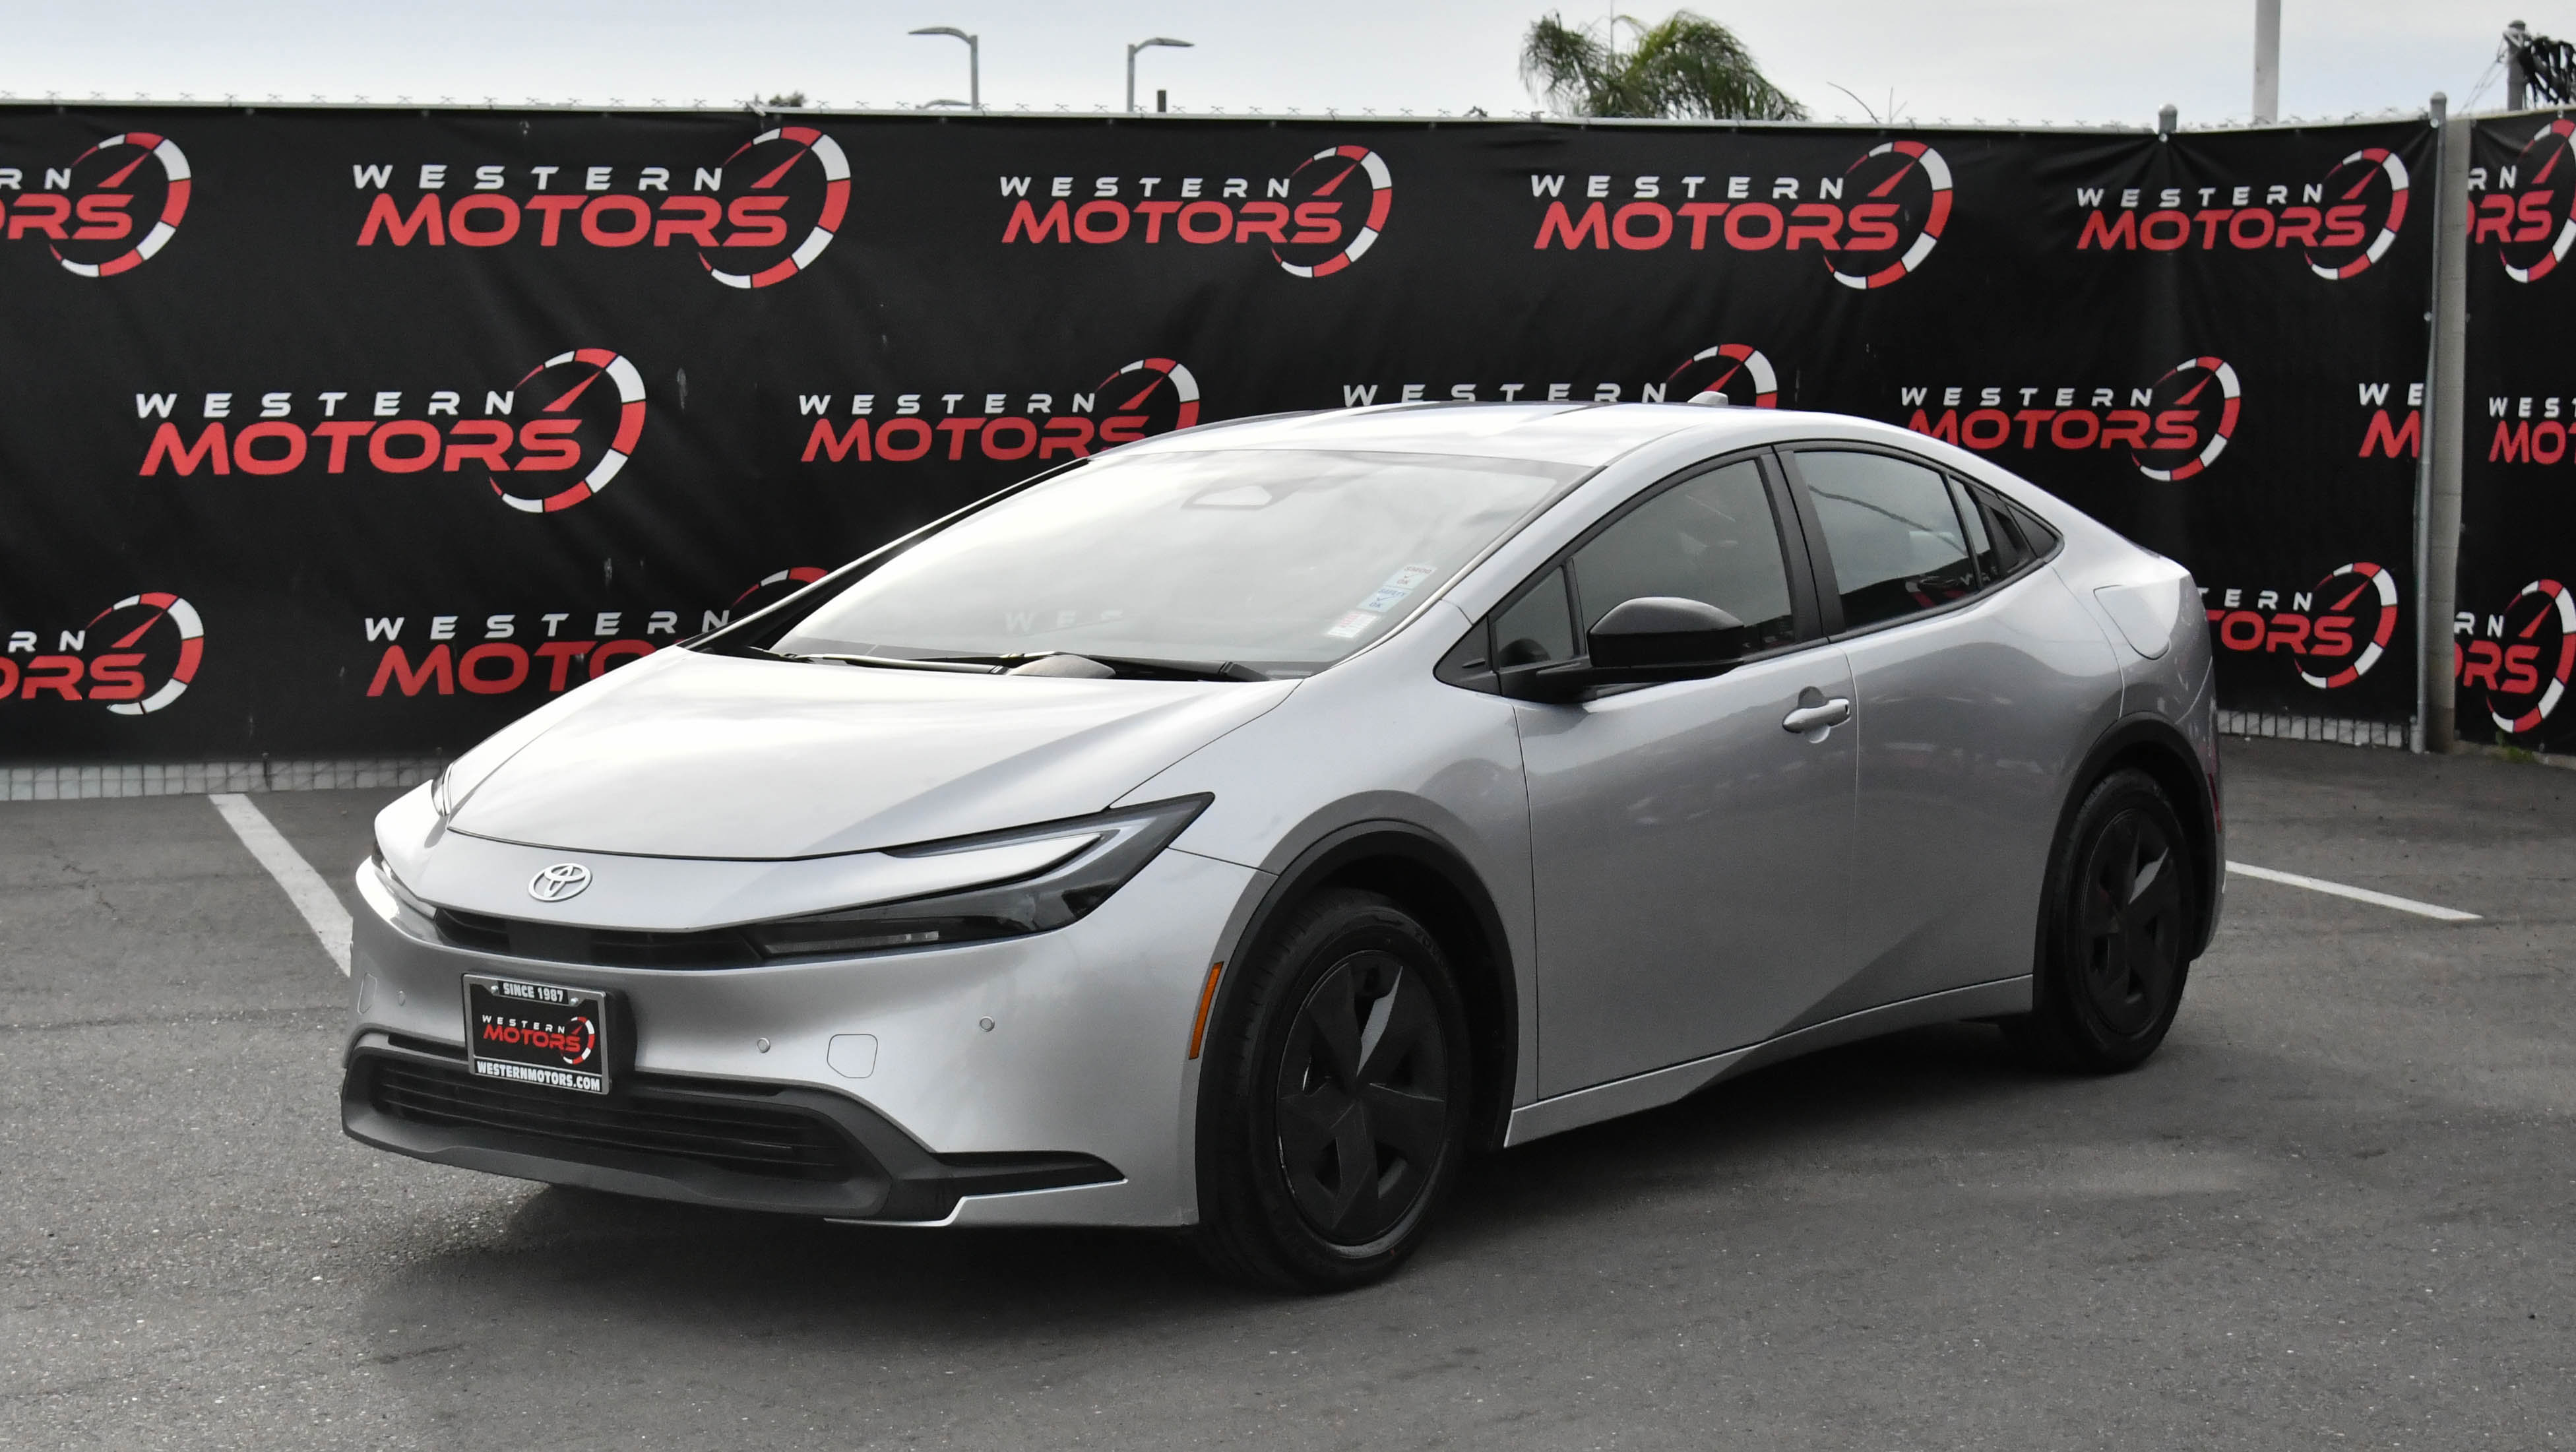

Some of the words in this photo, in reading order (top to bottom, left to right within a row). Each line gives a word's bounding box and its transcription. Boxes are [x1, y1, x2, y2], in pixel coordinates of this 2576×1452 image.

[354, 165, 722, 191] WESTERN
[1001, 177, 1290, 197] WESTERN
[1532, 175, 1843, 199] WESTERN
[2077, 184, 2322, 206] WESTERN
[0, 193, 134, 240] RS
[357, 193, 788, 247] MOTORS
[1003, 200, 1342, 244] MOTORS
[1534, 201, 1900, 251] MOTORS
[2077, 205, 2366, 250] MOTORS
[2466, 190, 2554, 243] RS
[137, 391, 514, 418] WESTERN
[800, 393, 1094, 415] WESTERN
[1902, 388, 2152, 406] WESTERN
[2490, 398, 2576, 417] WES
[801, 416, 1149, 462] MOTORS
[1908, 409, 2199, 450] MOTORS
[2489, 420, 2576, 464] MO
[139, 419, 582, 476] MOTORS
[363, 608, 731, 643] WESTERN
[2454, 633, 2540, 694] RS
[503, 983, 535, 999] SINCE
[538, 987, 563, 1002] 1987
[482, 1015, 565, 1034] WESTERN
[483, 1023, 581, 1053] MOTORS
[476, 1060, 600, 1092] WESTERNMOTORS.COM
